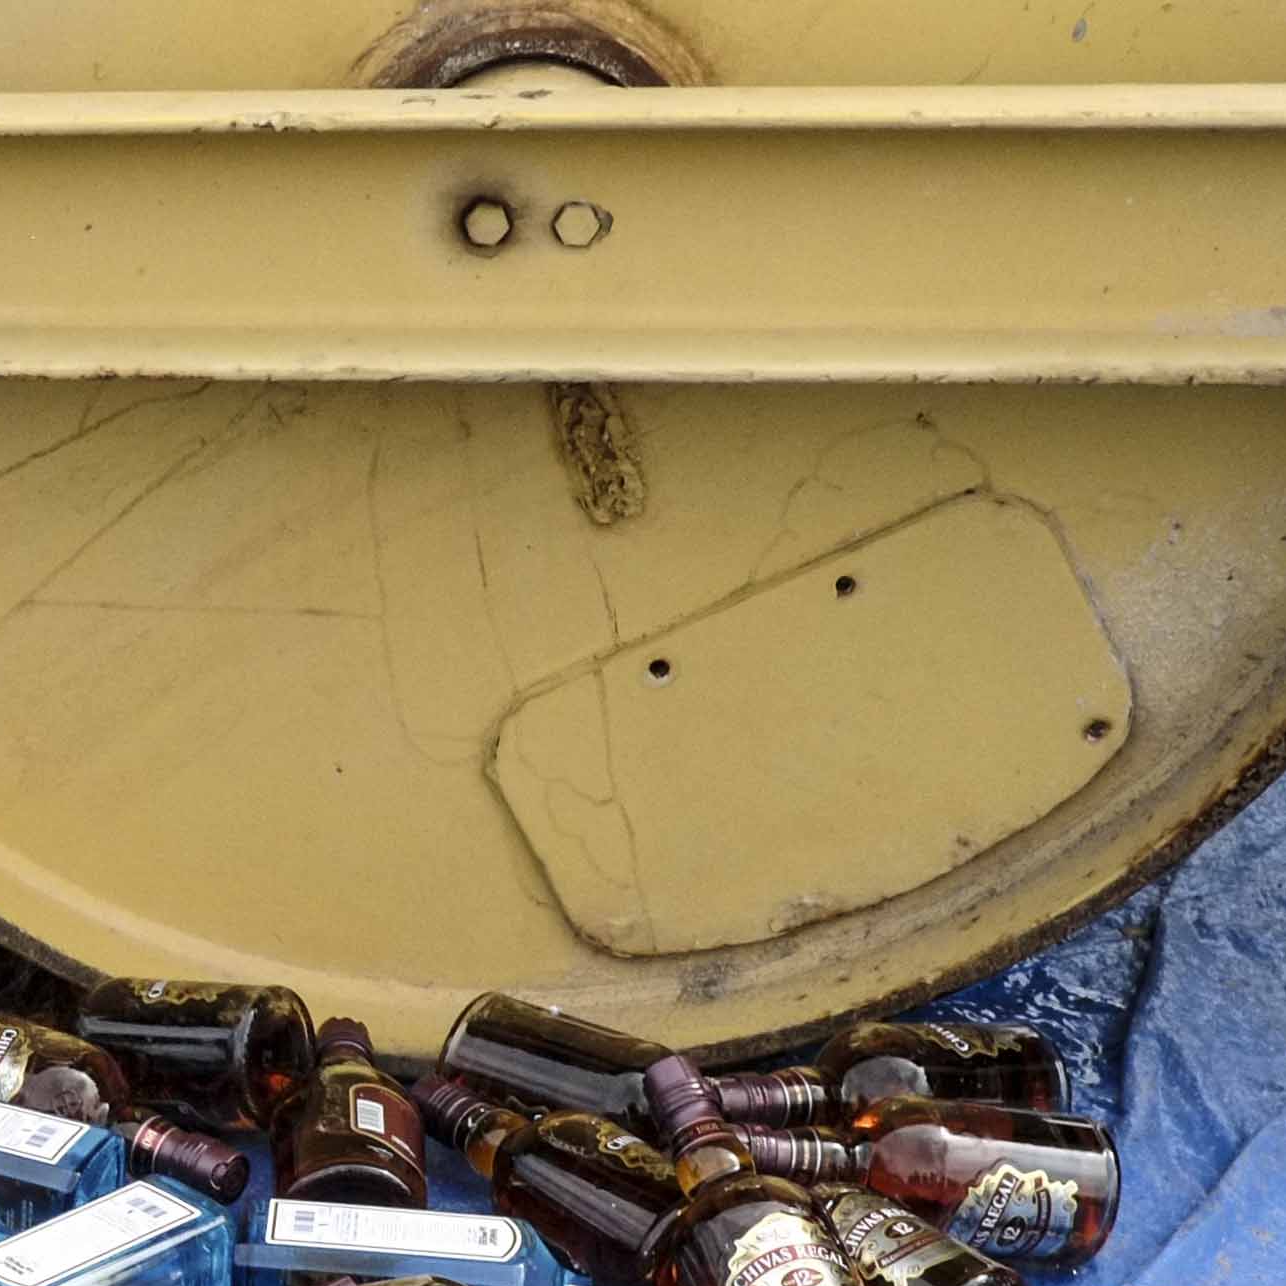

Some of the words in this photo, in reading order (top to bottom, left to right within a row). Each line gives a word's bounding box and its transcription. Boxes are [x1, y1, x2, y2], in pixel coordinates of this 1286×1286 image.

[982, 1177, 1016, 1231] REGAL
[898, 1222, 915, 1235] 12
[1003, 1226, 1020, 1242] 12
[796, 1244, 848, 1270] REGAL
